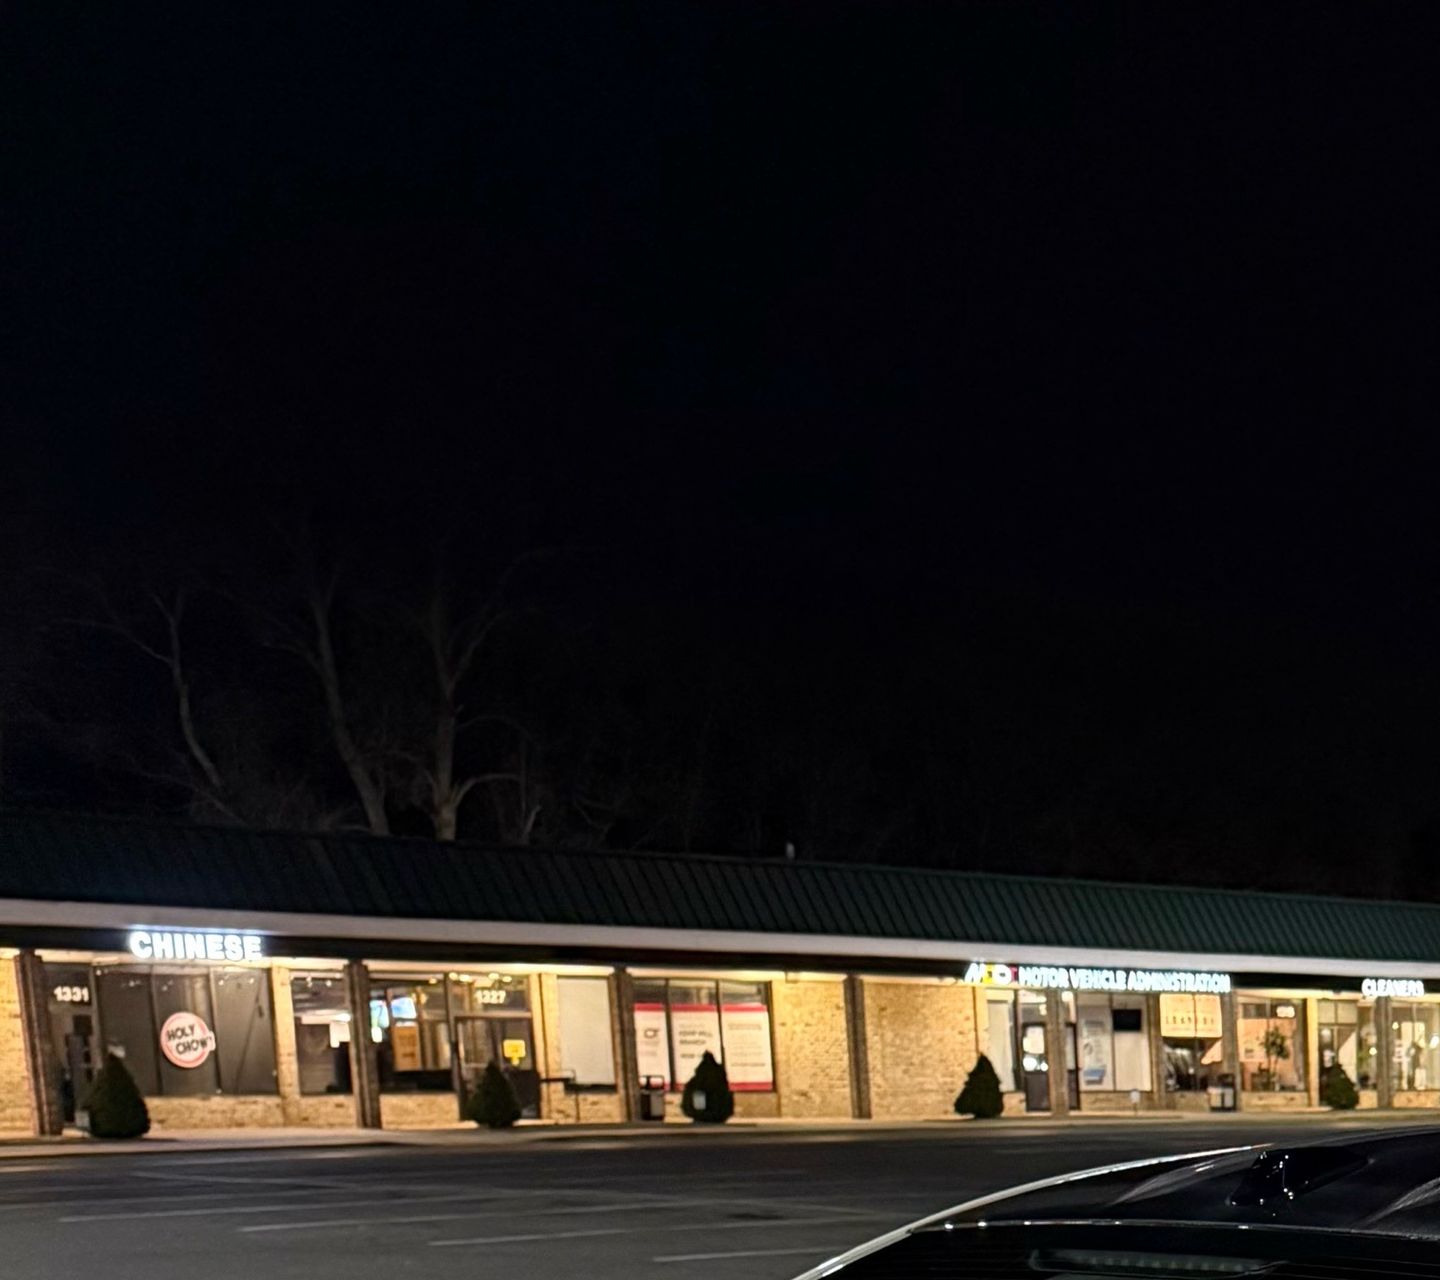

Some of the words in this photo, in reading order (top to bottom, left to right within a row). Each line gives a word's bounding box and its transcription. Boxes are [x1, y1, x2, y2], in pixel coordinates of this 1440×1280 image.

[130, 931, 262, 961] CHINESE
[1019, 966, 1069, 988] MOTOR
[1069, 968, 1127, 990] VEHICLE
[1128, 970, 1231, 994] ADMINISTRATION
[1361, 978, 1425, 997] CLEANERS
[54, 986, 90, 1002] 1331
[167, 1023, 195, 1041] HOLY
